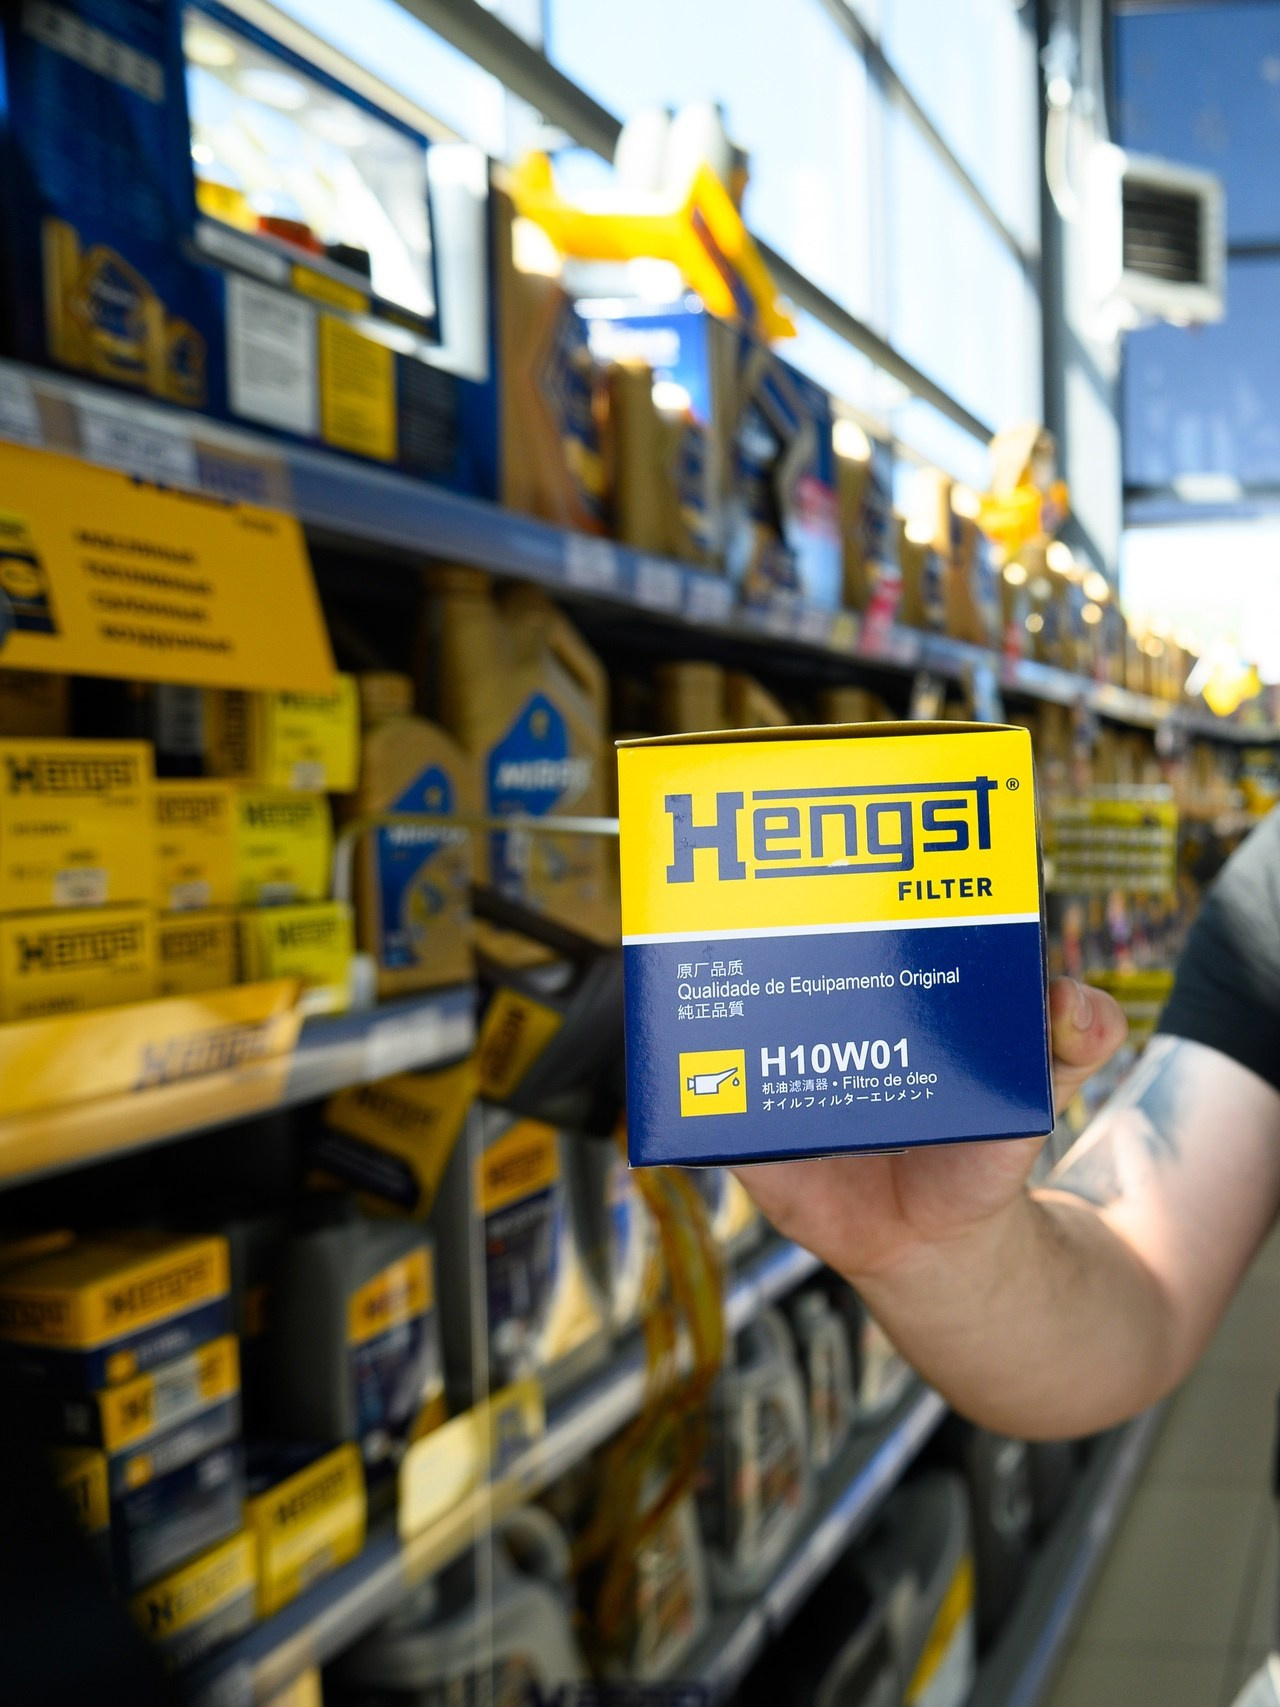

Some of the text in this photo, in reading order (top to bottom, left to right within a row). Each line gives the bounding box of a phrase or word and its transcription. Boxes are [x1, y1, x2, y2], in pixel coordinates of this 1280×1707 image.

[665, 776, 998, 884] Hengst
[897, 876, 994, 902] FILTER
[676, 958, 745, 980] 原厂品质
[677, 966, 961, 1002] Qualidade de Equipamento Original
[677, 1000, 745, 1021] 純正品質
[760, 1037, 909, 1078] H10W01
[762, 1070, 938, 1096] 机油滤清器 Filtro de óleo
[762, 1087, 935, 1112] オイルフィルターエレメント
